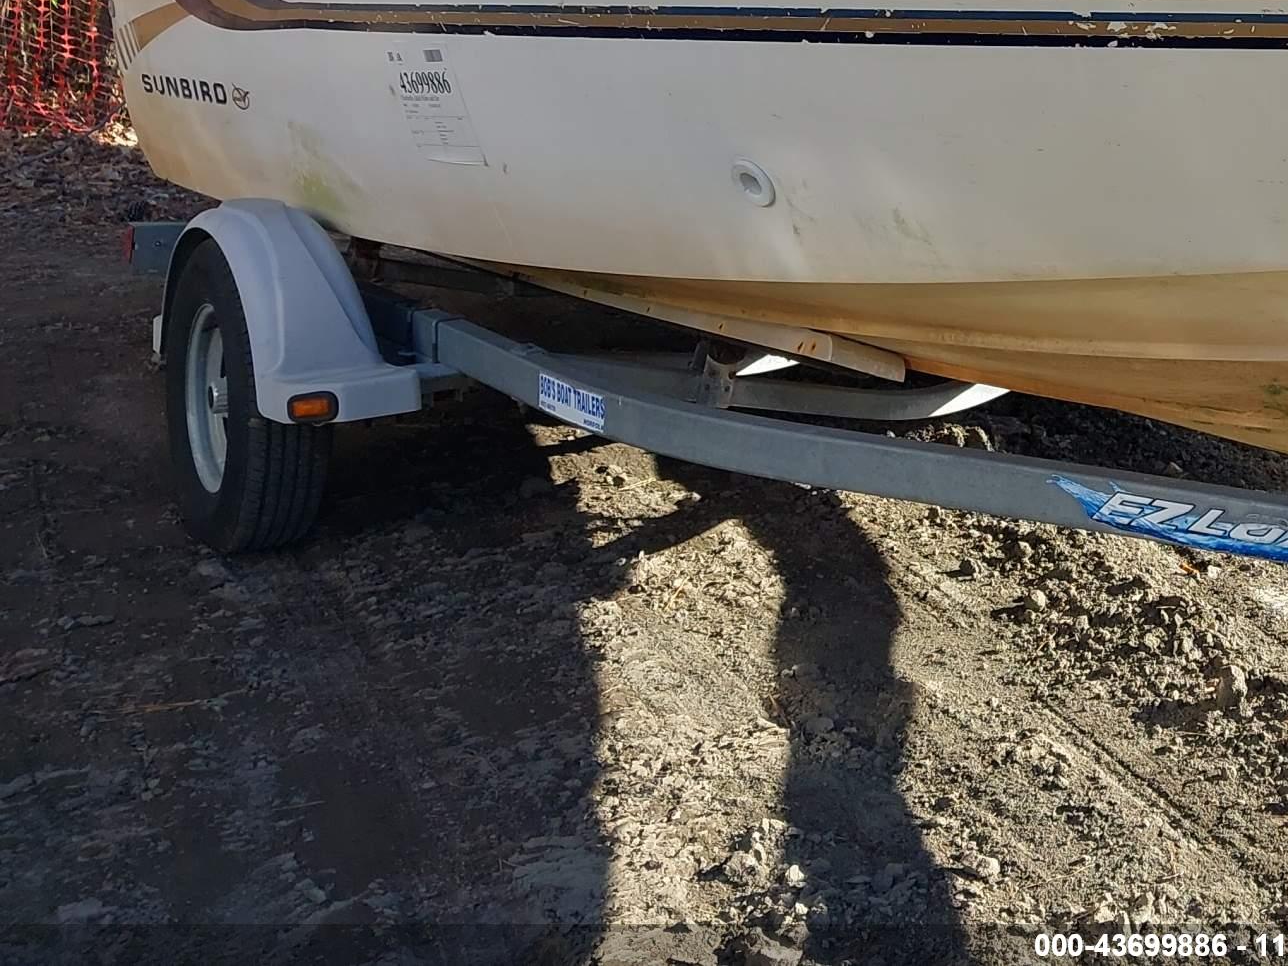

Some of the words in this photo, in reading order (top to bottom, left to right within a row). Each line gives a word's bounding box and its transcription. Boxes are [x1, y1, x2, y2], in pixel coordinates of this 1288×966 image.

[141, 74, 228, 106] SUNBIRD
[400, 71, 452, 94] 43699886
[556, 382, 572, 408] BOAT
[573, 389, 605, 420] TRAILERS
[1092, 491, 1195, 531] EZ
